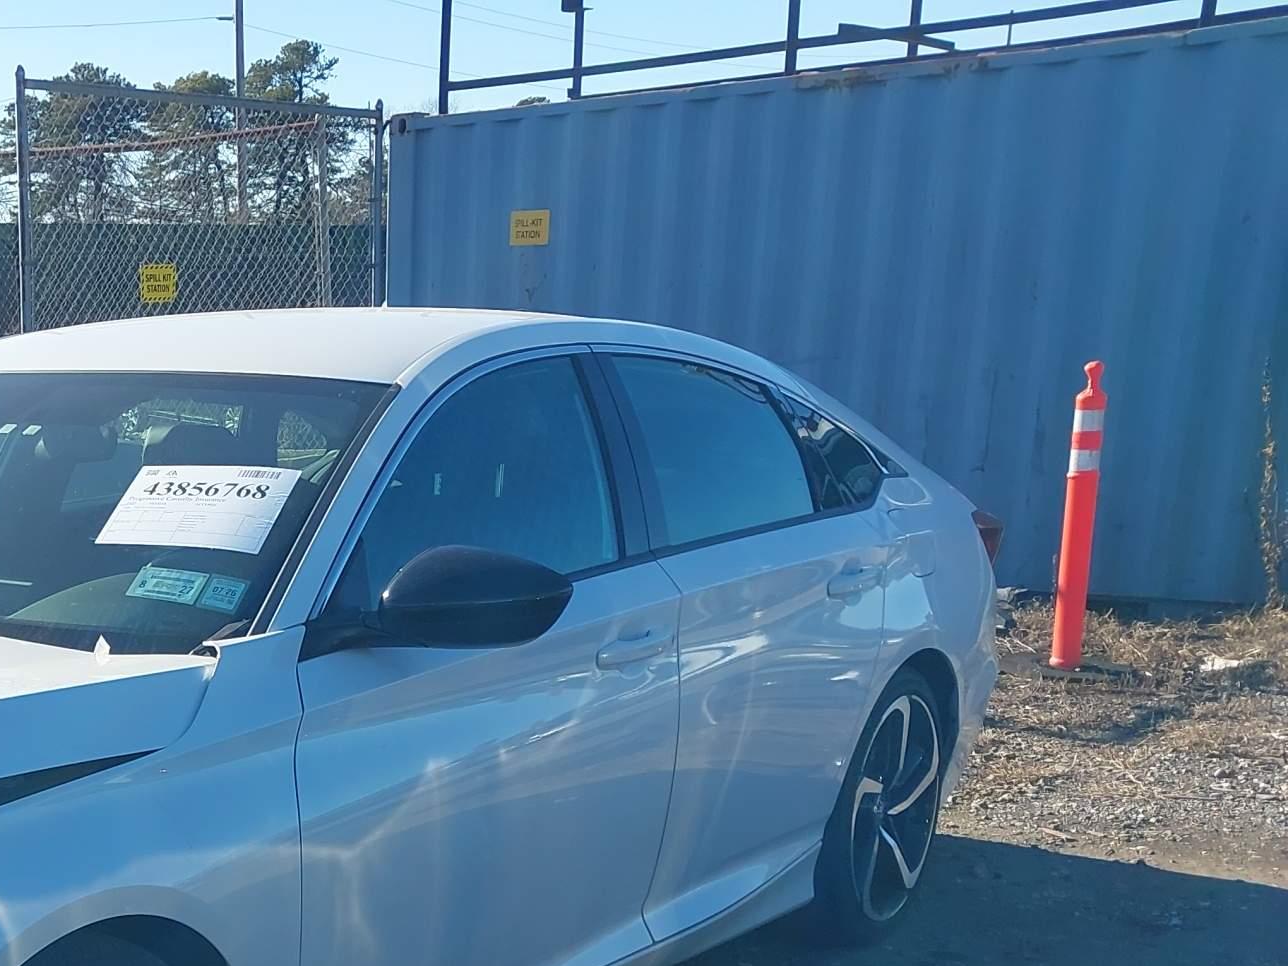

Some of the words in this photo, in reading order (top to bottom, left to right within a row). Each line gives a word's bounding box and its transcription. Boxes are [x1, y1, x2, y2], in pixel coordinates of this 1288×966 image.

[145, 273, 162, 283] SPILL
[163, 273, 172, 282] KIT
[146, 284, 170, 293] STATION
[143, 481, 270, 500] 43856768
[179, 585, 194, 595] 27
